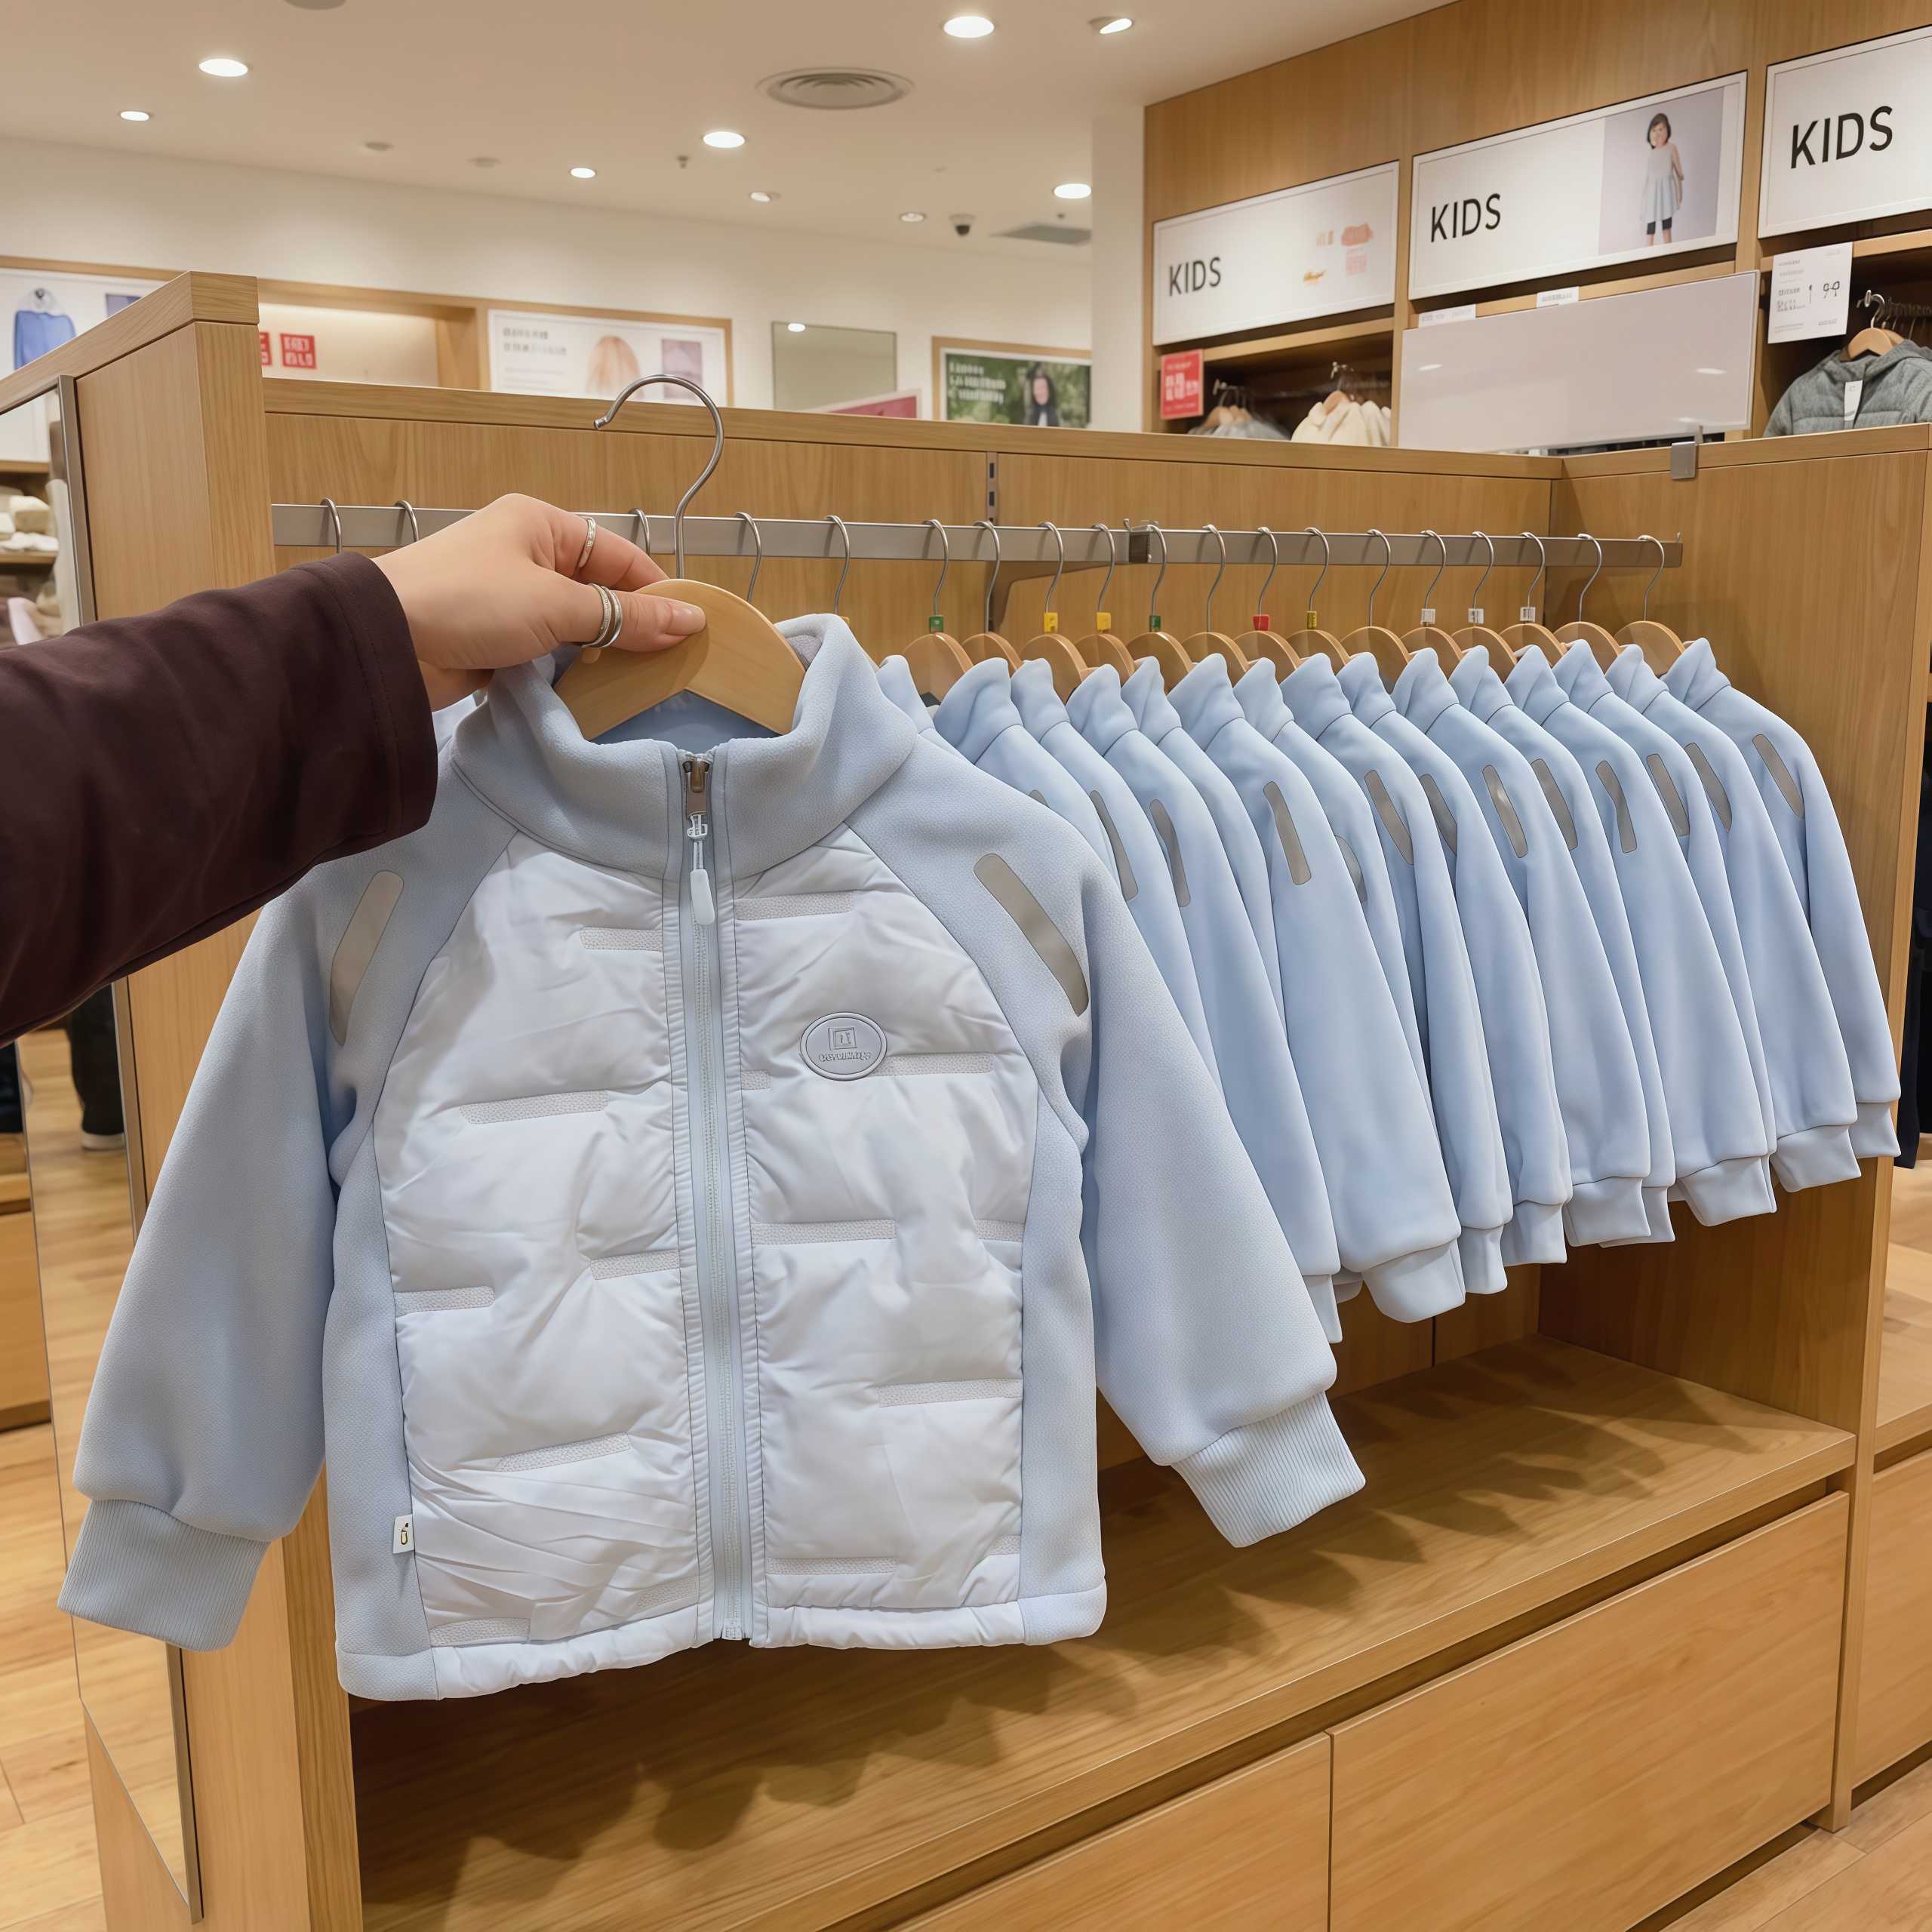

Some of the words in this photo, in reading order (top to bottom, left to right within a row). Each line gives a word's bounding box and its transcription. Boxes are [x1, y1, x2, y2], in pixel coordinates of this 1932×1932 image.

[1790, 105, 1893, 169] KIDS
[1430, 192, 1501, 243] KIDS
[1168, 256, 1221, 297] KIDS
